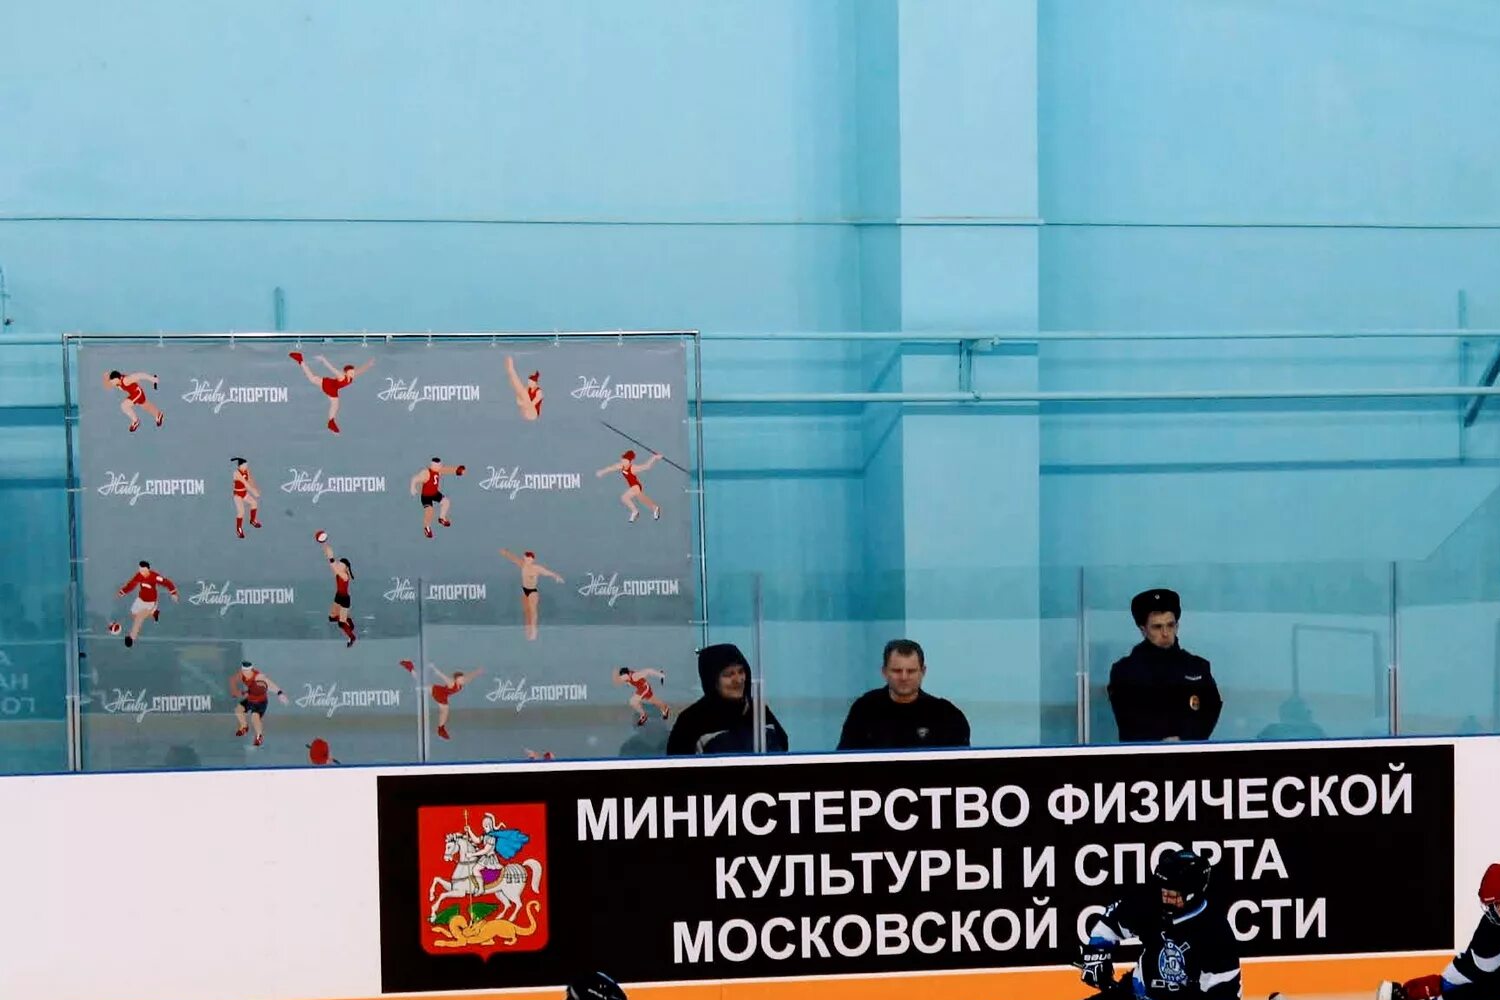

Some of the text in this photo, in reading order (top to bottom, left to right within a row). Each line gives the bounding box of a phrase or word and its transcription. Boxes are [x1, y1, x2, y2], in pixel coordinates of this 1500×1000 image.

[182, 376, 288, 414] Живу СПОРТОМ
[377, 376, 480, 411] Живу СПОРТОМ
[571, 375, 671, 410] Живу СПОРТОМ
[98, 471, 205, 506] Живу СПОРТОМ
[281, 467, 386, 503] Живу СПОРТОМ
[479, 465, 581, 500] Живу СПОРТОМ
[189, 580, 294, 616] Живу СПОРТОМ
[384, 577, 486, 601] Жи СПОРТОМ
[577, 571, 679, 606] Живу СПОРТОМ
[104, 688, 211, 724] Живу СПОРТОМ
[295, 681, 400, 719] Живу СПОРТОМ
[486, 677, 587, 713] Живу СПОРТОМ
[577, 763, 1413, 841] МИНИСТЕРСТВО ФИЗИЧЕСКОЙ
[715, 847, 1003, 899] КУЛЬТУРЫ
[1023, 845, 1056, 888] И
[673, 897, 1327, 964] МОСКОВСКОЙ ОСТИ
